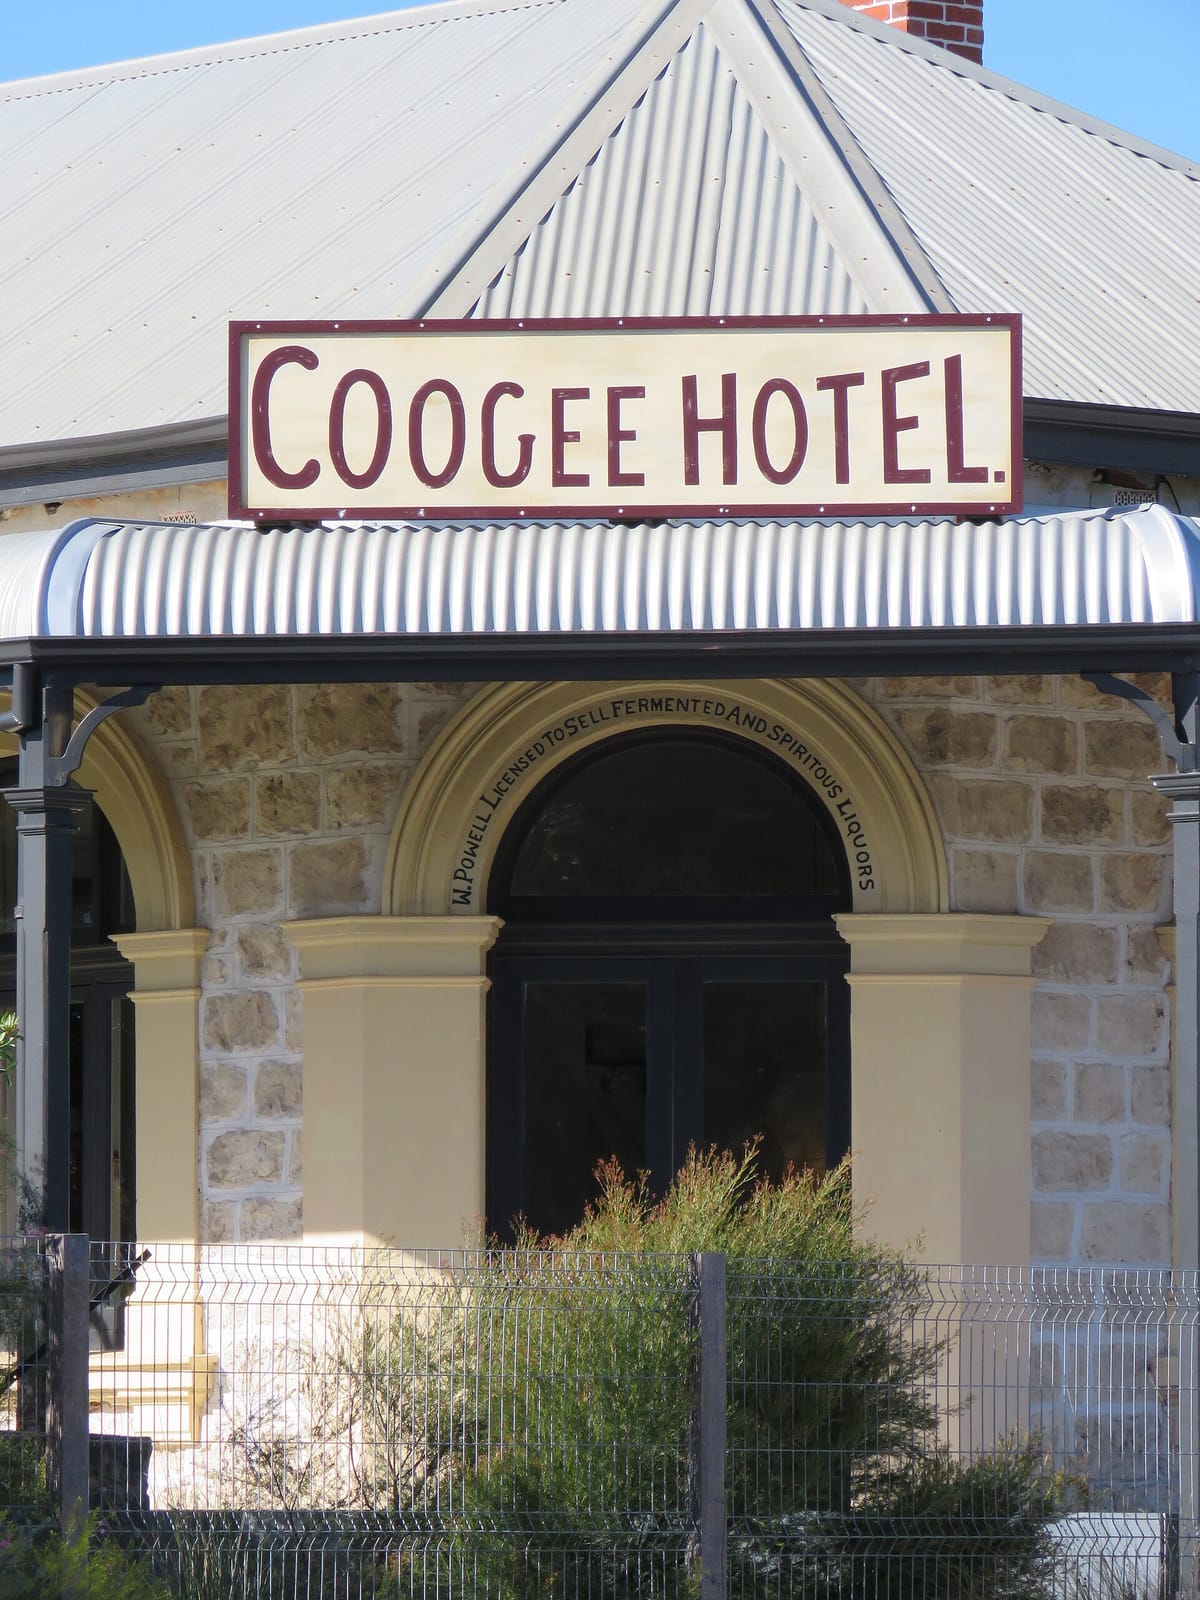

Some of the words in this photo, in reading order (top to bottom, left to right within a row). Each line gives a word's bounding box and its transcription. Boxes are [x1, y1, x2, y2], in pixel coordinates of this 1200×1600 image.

[252, 345, 646, 490] COOGEE
[682, 353, 1006, 486] HOTEL.
[453, 813, 492, 884] POWELL
[480, 742, 545, 810] LICENSED
[541, 728, 565, 747] TO
[564, 707, 610, 737] SELL
[610, 697, 726, 718] FERMENTED
[725, 706, 767, 734] AND
[766, 724, 843, 799] SPIRITOUS
[836, 797, 874, 891] LIQUORS
